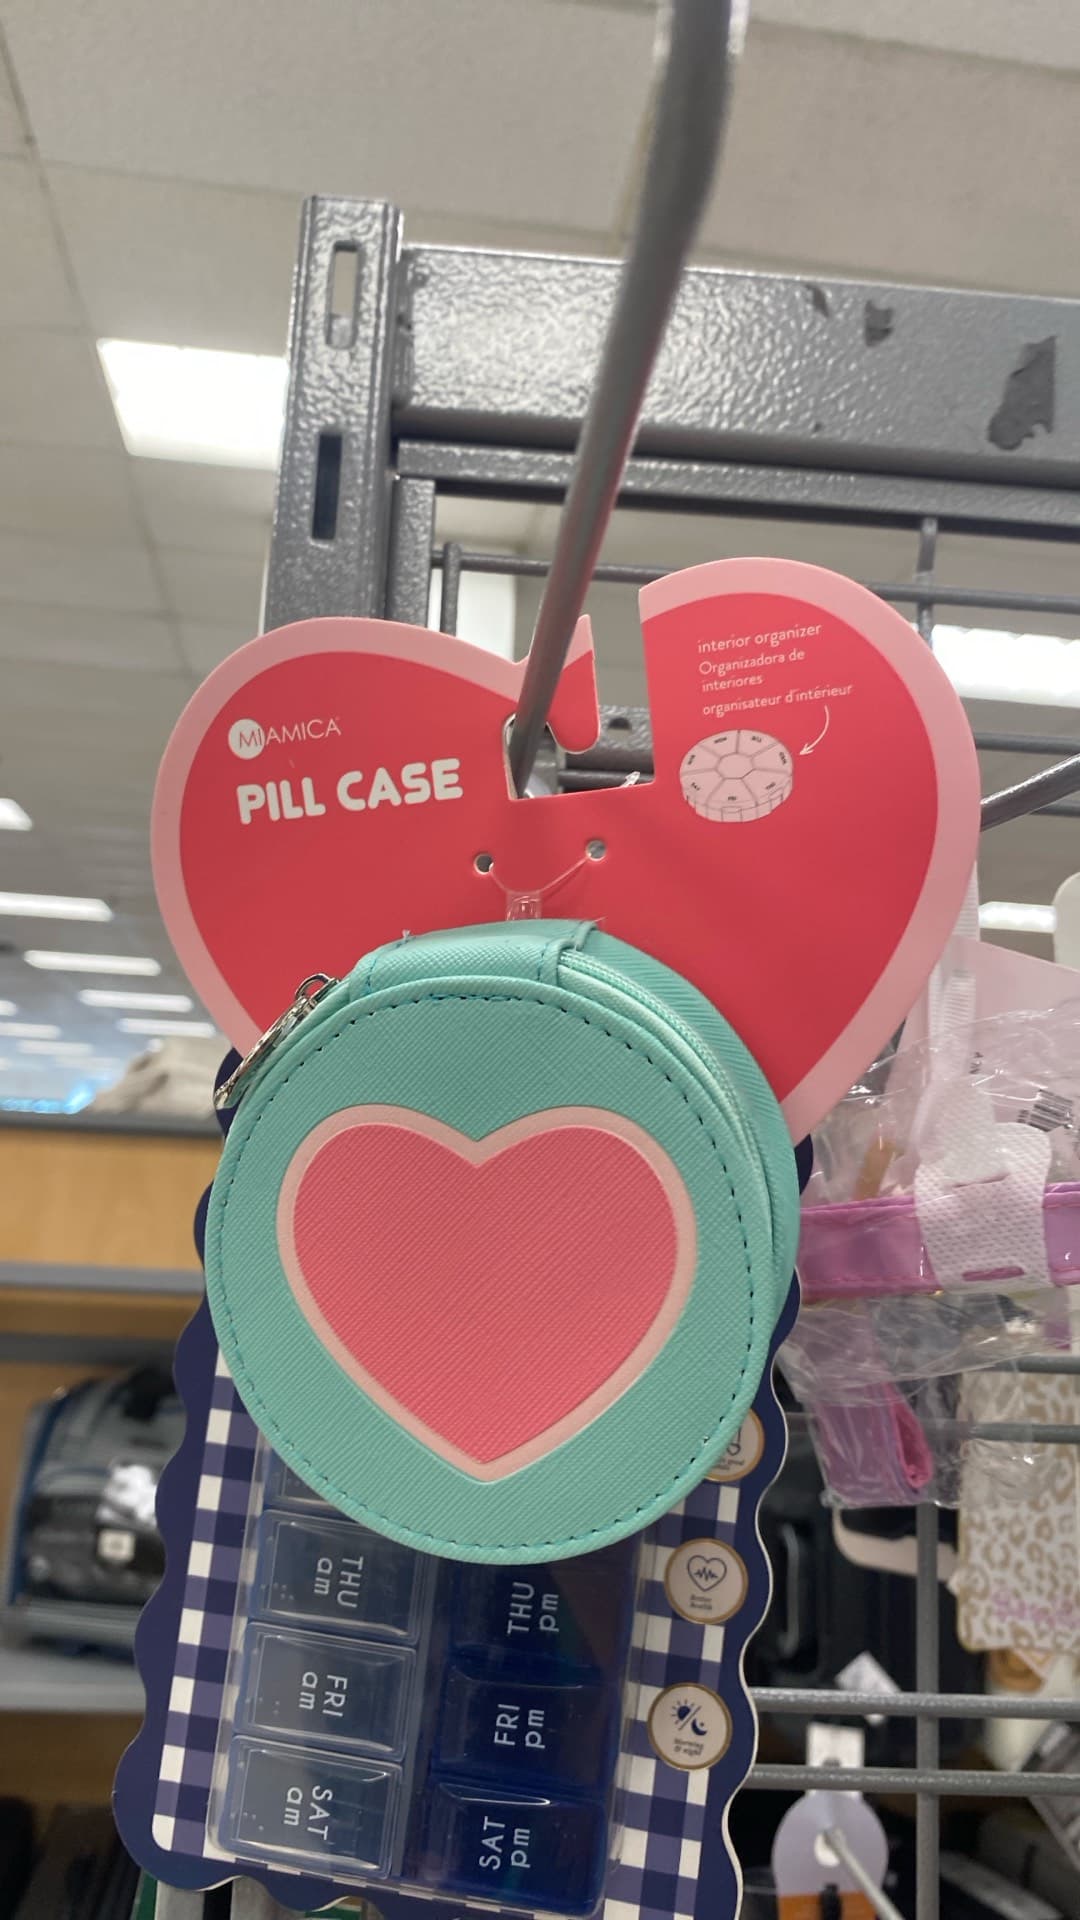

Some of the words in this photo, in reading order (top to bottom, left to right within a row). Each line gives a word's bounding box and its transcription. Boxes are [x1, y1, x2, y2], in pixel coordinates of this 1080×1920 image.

[698, 634, 751, 653] interior
[754, 624, 822, 647] organizer
[699, 651, 785, 677] Organizadora
[788, 648, 805, 661] de
[702, 674, 763, 692] interiores
[703, 696, 782, 718] organisateur
[233, 718, 342, 751] MIAMICA
[236, 777, 326, 825] PILL
[336, 758, 464, 811] CASE
[314, 1557, 333, 1597] am
[337, 1556, 364, 1609] THU
[507, 1582, 535, 1635] THU
[539, 1593, 559, 1633] pm
[299, 1671, 318, 1711] am
[322, 1674, 348, 1718] FRI
[494, 1703, 520, 1746] FRI
[525, 1708, 545, 1749] pm
[283, 1786, 302, 1827] am
[307, 1784, 333, 1841] SAT
[479, 1815, 506, 1871] SAT
[511, 1828, 531, 1869] pm
